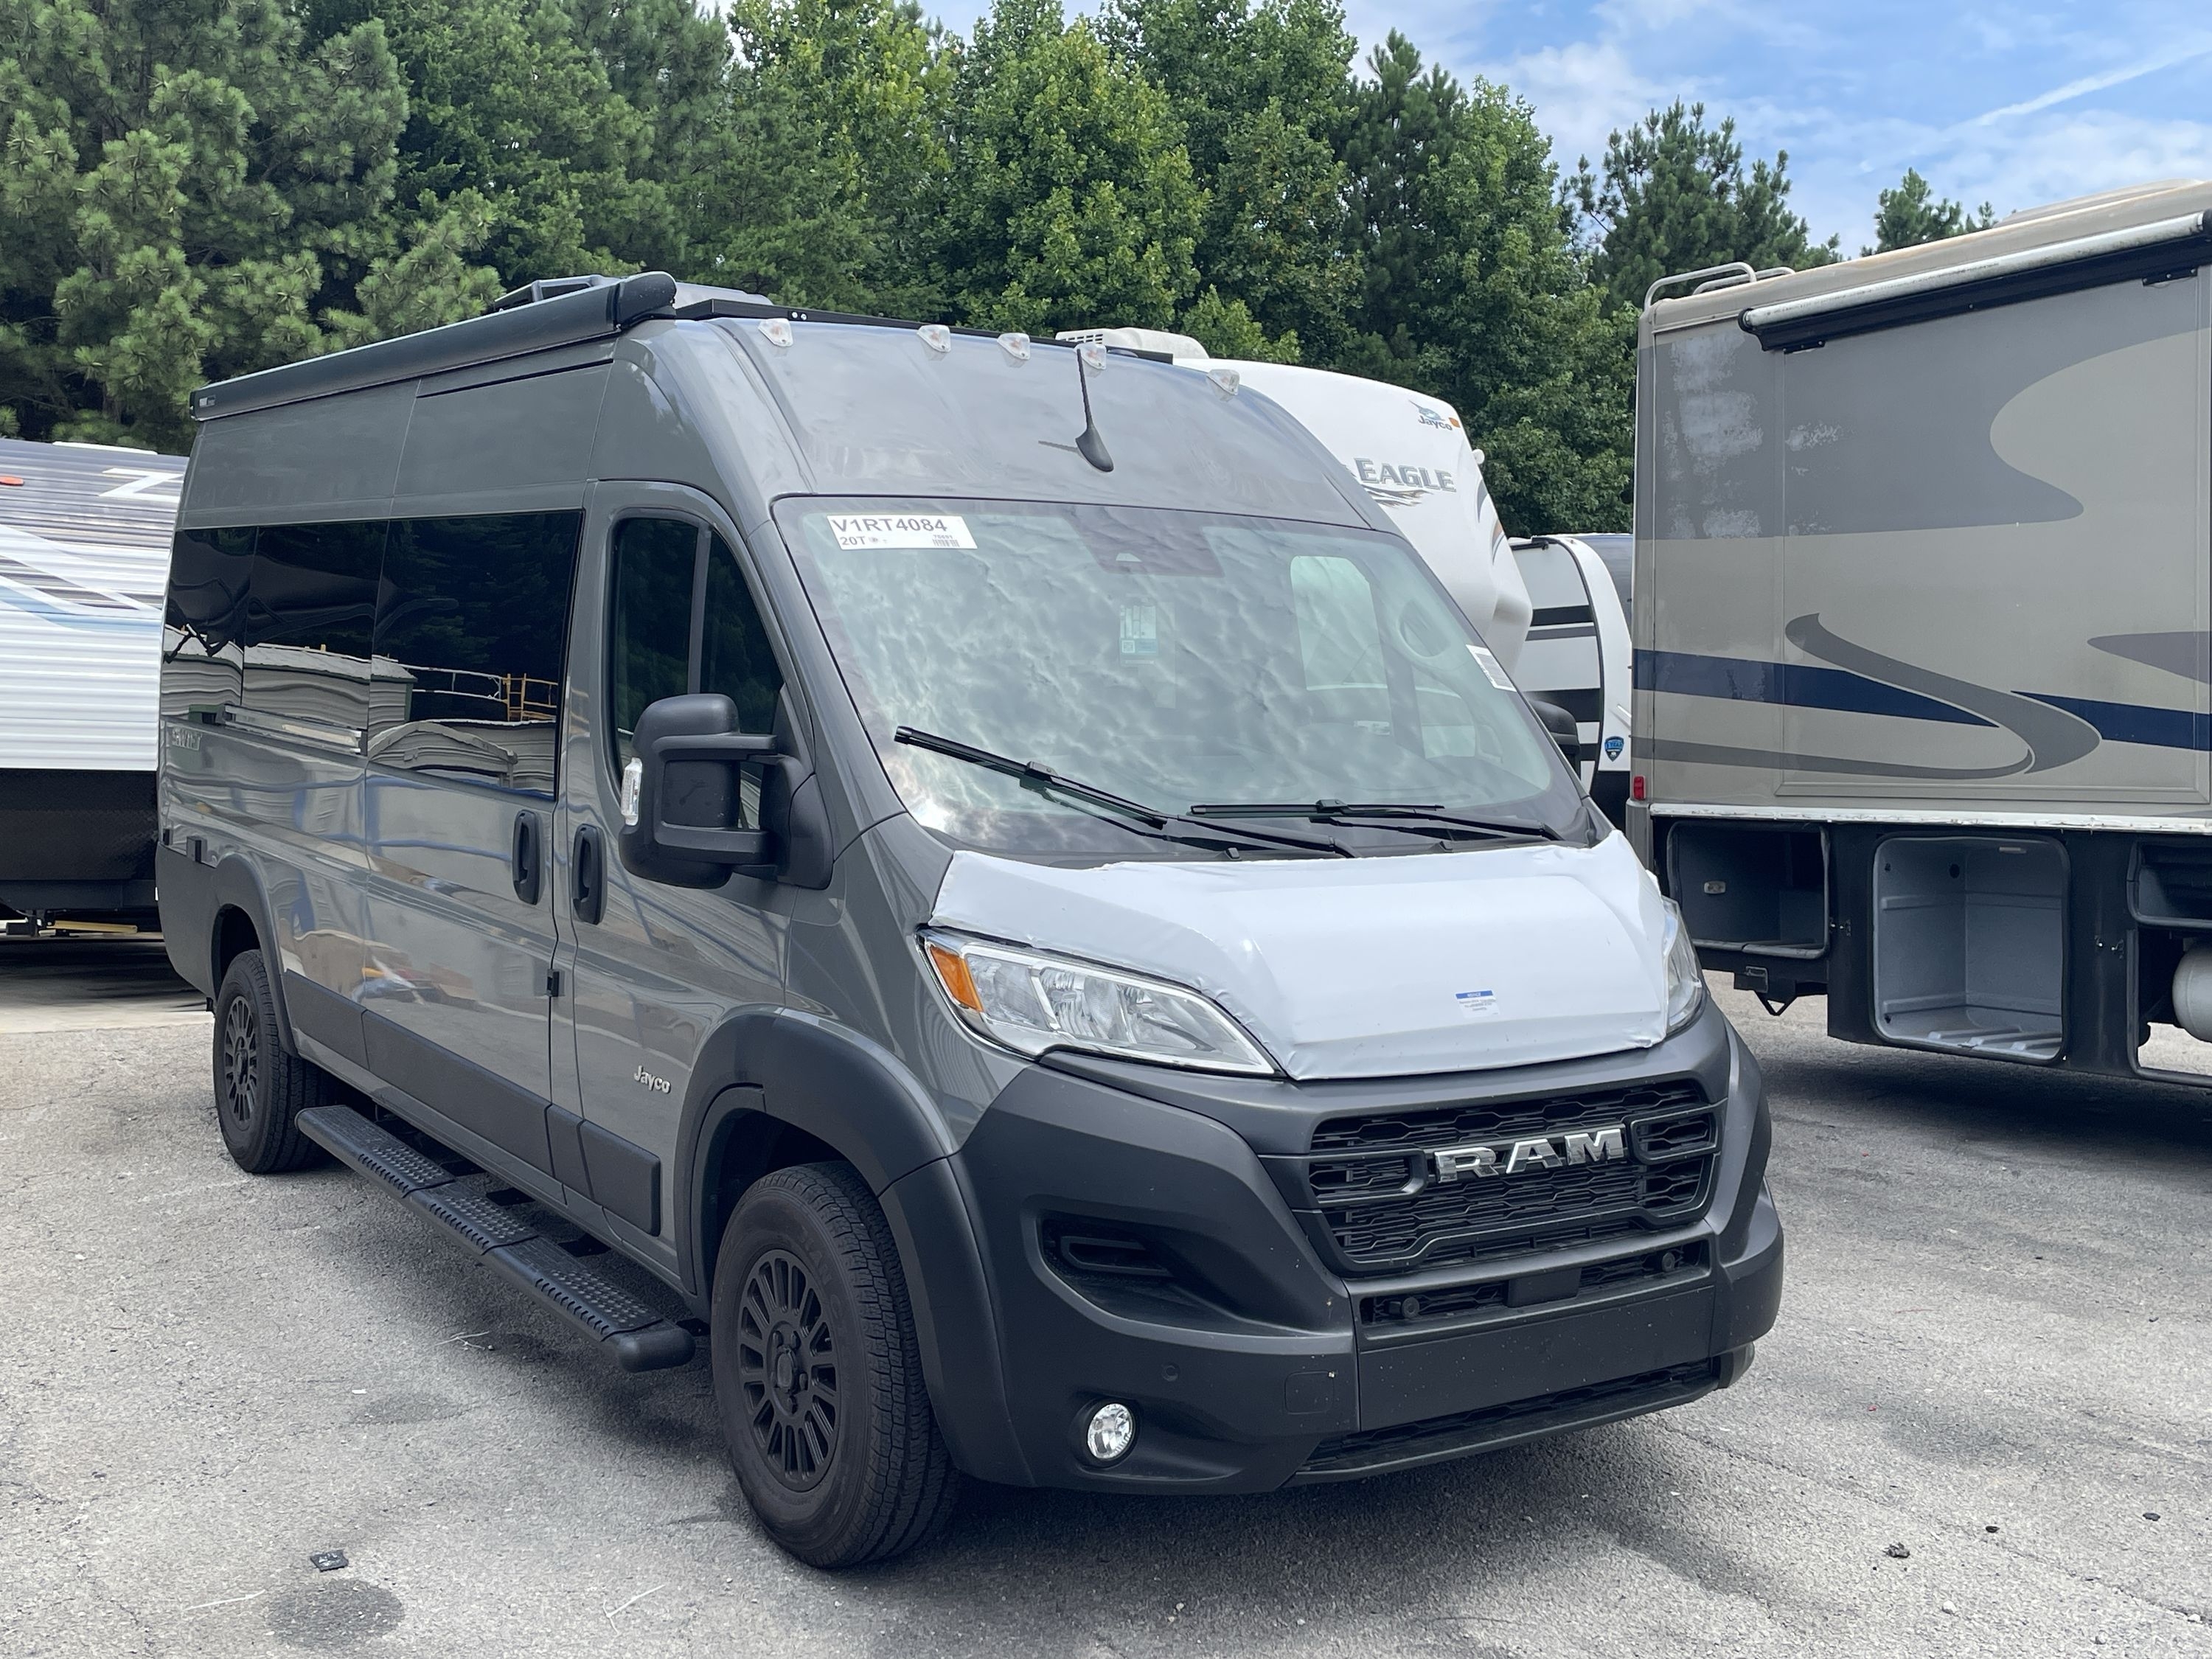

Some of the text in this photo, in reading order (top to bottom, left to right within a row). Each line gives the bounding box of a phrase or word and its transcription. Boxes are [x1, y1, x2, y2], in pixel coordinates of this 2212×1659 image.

[1417, 414, 1453, 431] Jayco
[1354, 457, 1457, 493] EAGLE
[830, 518, 948, 532] V1RT4084
[839, 535, 866, 546] 20T
[634, 1065, 672, 1094] Jayco
[1434, 1128, 1625, 1183] RAM
